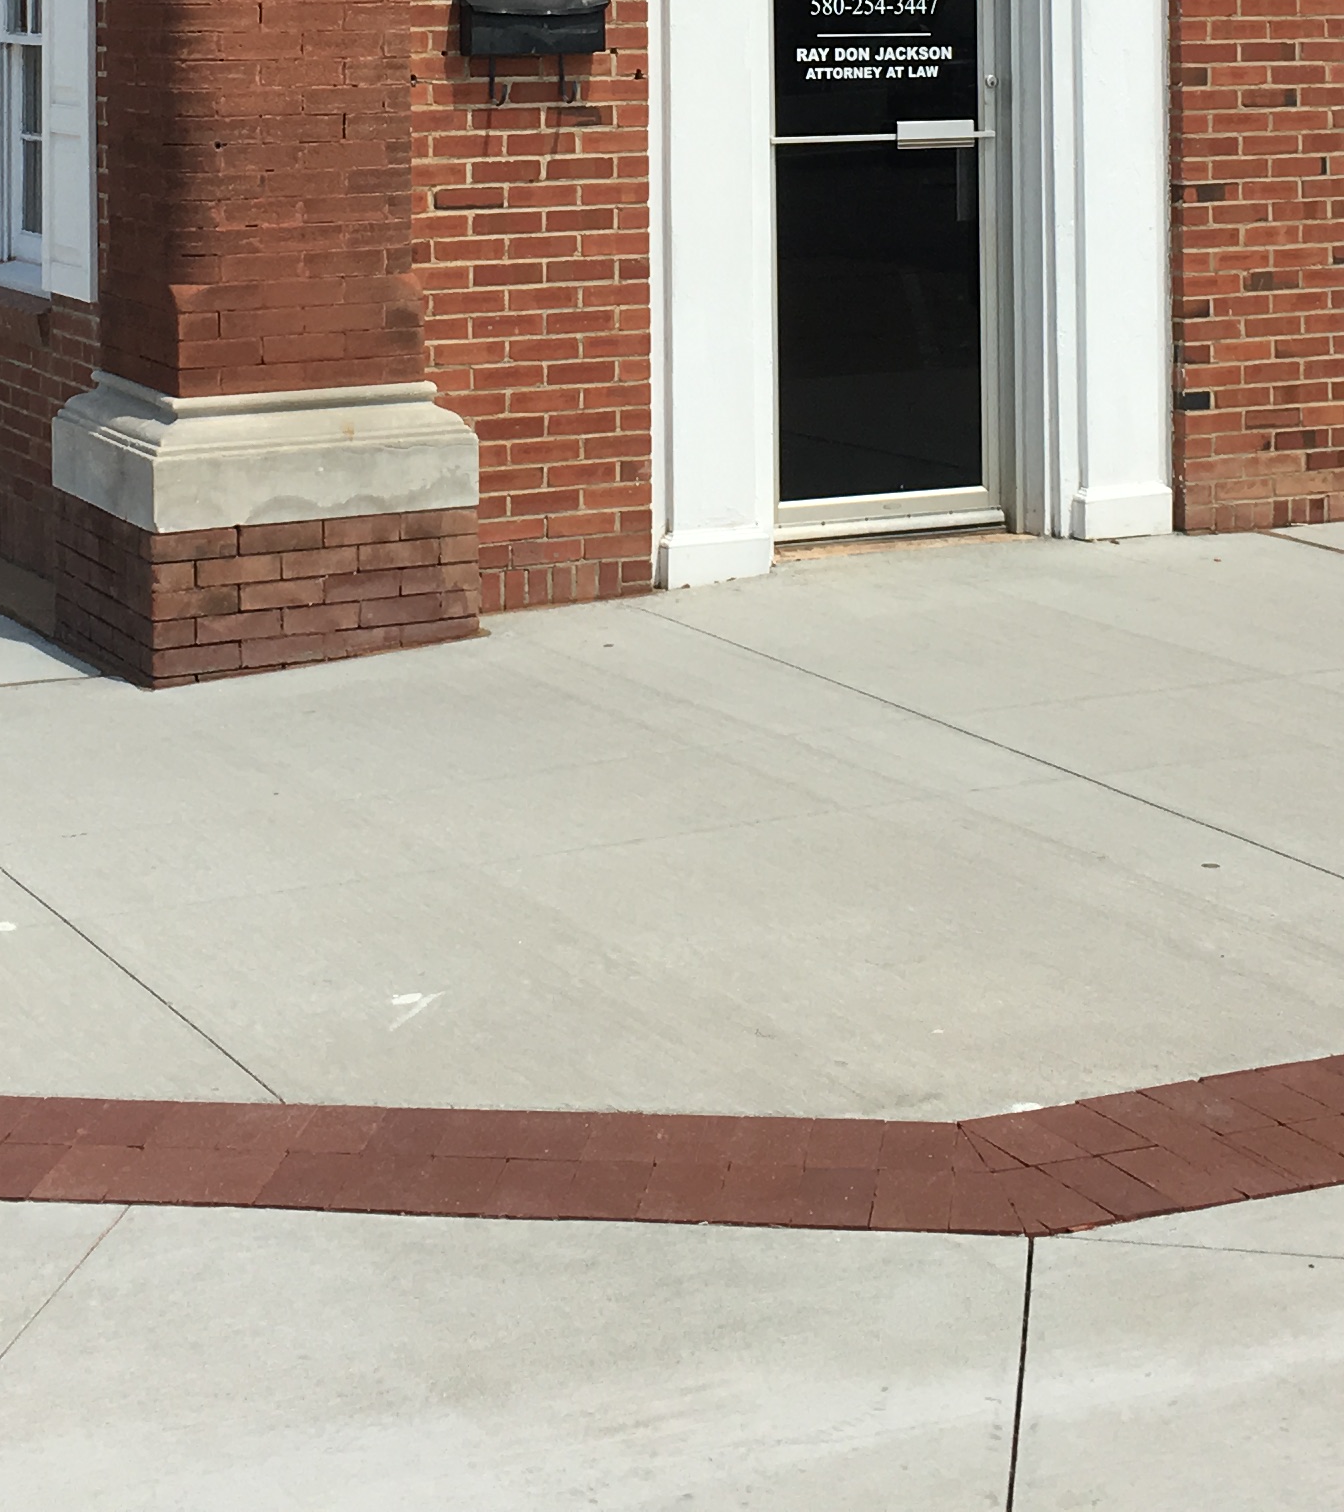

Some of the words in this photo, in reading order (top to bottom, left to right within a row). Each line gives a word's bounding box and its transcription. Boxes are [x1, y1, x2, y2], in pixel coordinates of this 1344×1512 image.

[796, 48, 829, 62] RAY
[834, 47, 870, 61] DON
[875, 46, 953, 61] JACKSON
[806, 66, 882, 80] ATTORNEY
[886, 66, 904, 79] AT
[908, 65, 939, 79] LAW
